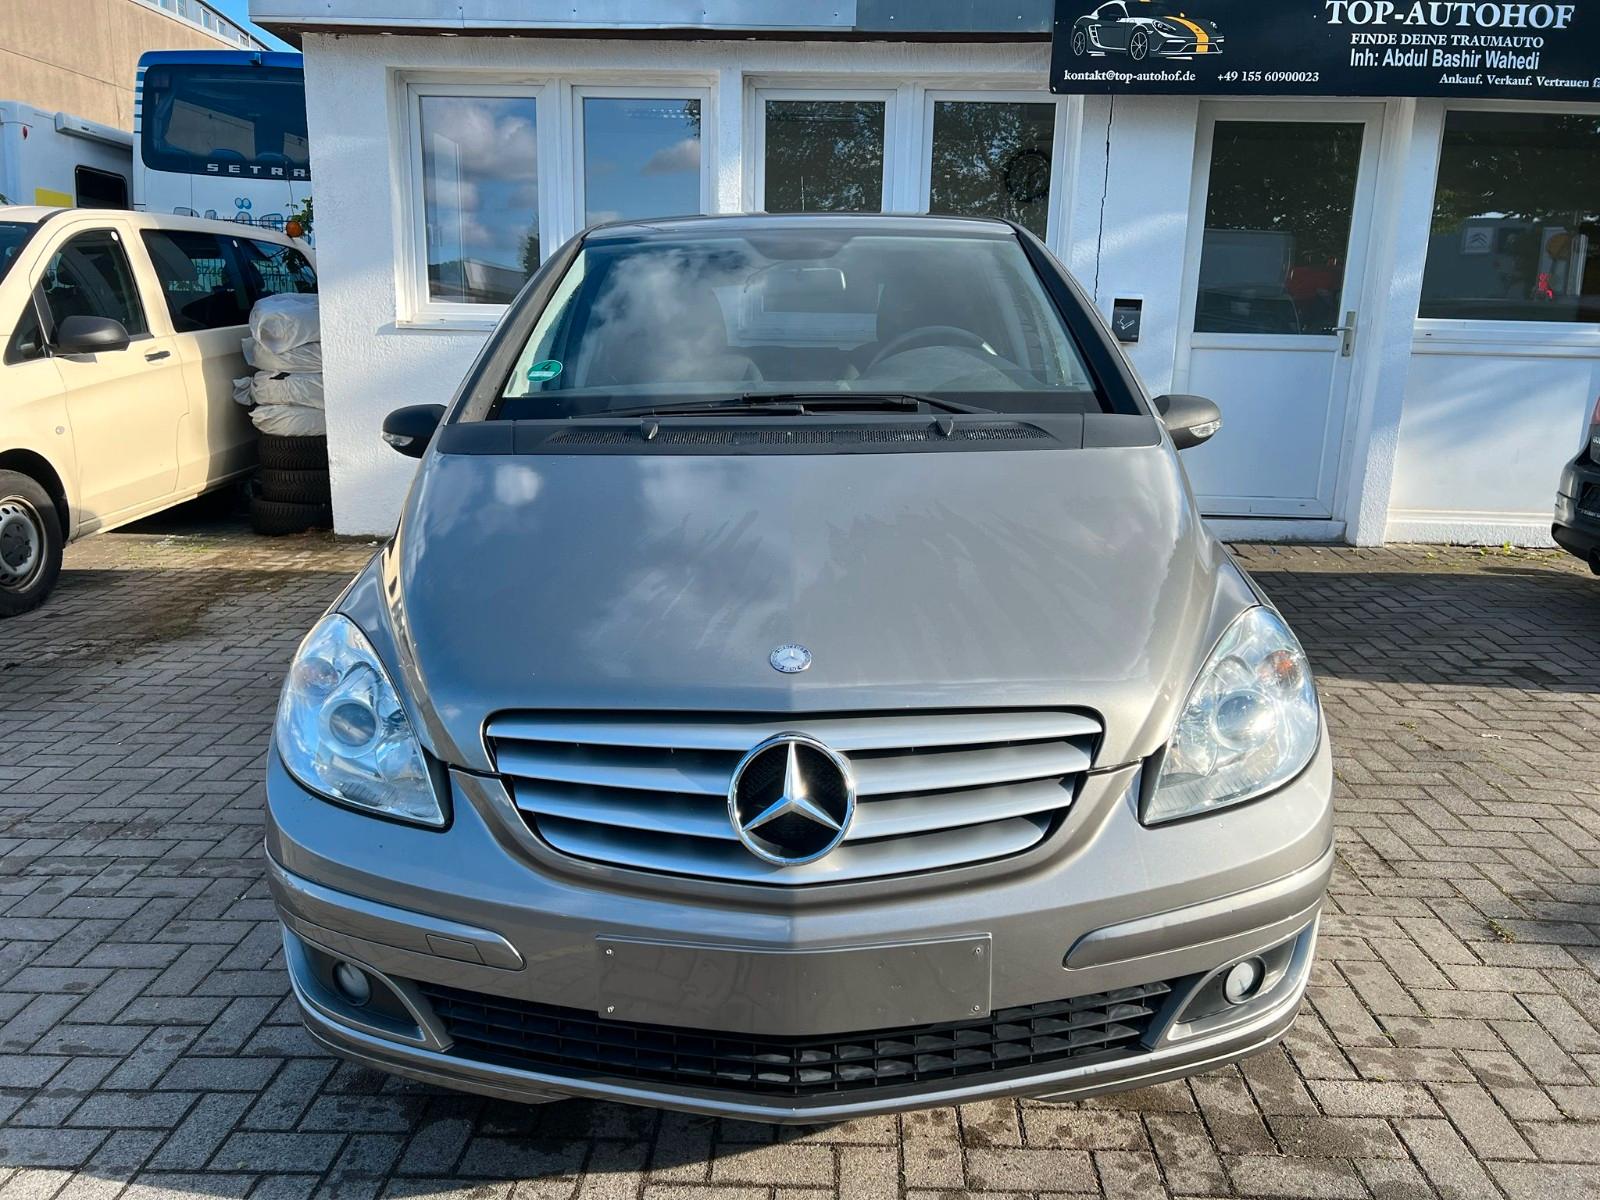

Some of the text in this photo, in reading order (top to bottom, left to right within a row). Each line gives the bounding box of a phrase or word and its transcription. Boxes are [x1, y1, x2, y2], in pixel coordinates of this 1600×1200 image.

[1325, 0, 1576, 29] TOP-AUTOHOF
[1350, 33, 1544, 48] FINDE DEINE TRAUMAUTO
[1350, 48, 1540, 70] Inh: Abdul Bashir Wahedi
[1064, 70, 1196, 84] kontakt@top-autohof.de
[1217, 71, 1320, 82] +49 155 60900023
[1439, 73, 1483, 85] Ankauf.
[1487, 74, 1533, 86] Verkauf.
[1536, 76, 1590, 88] Vertrauen
[207, 164, 305, 177] SETRA
[541, 361, 552, 371] 4
